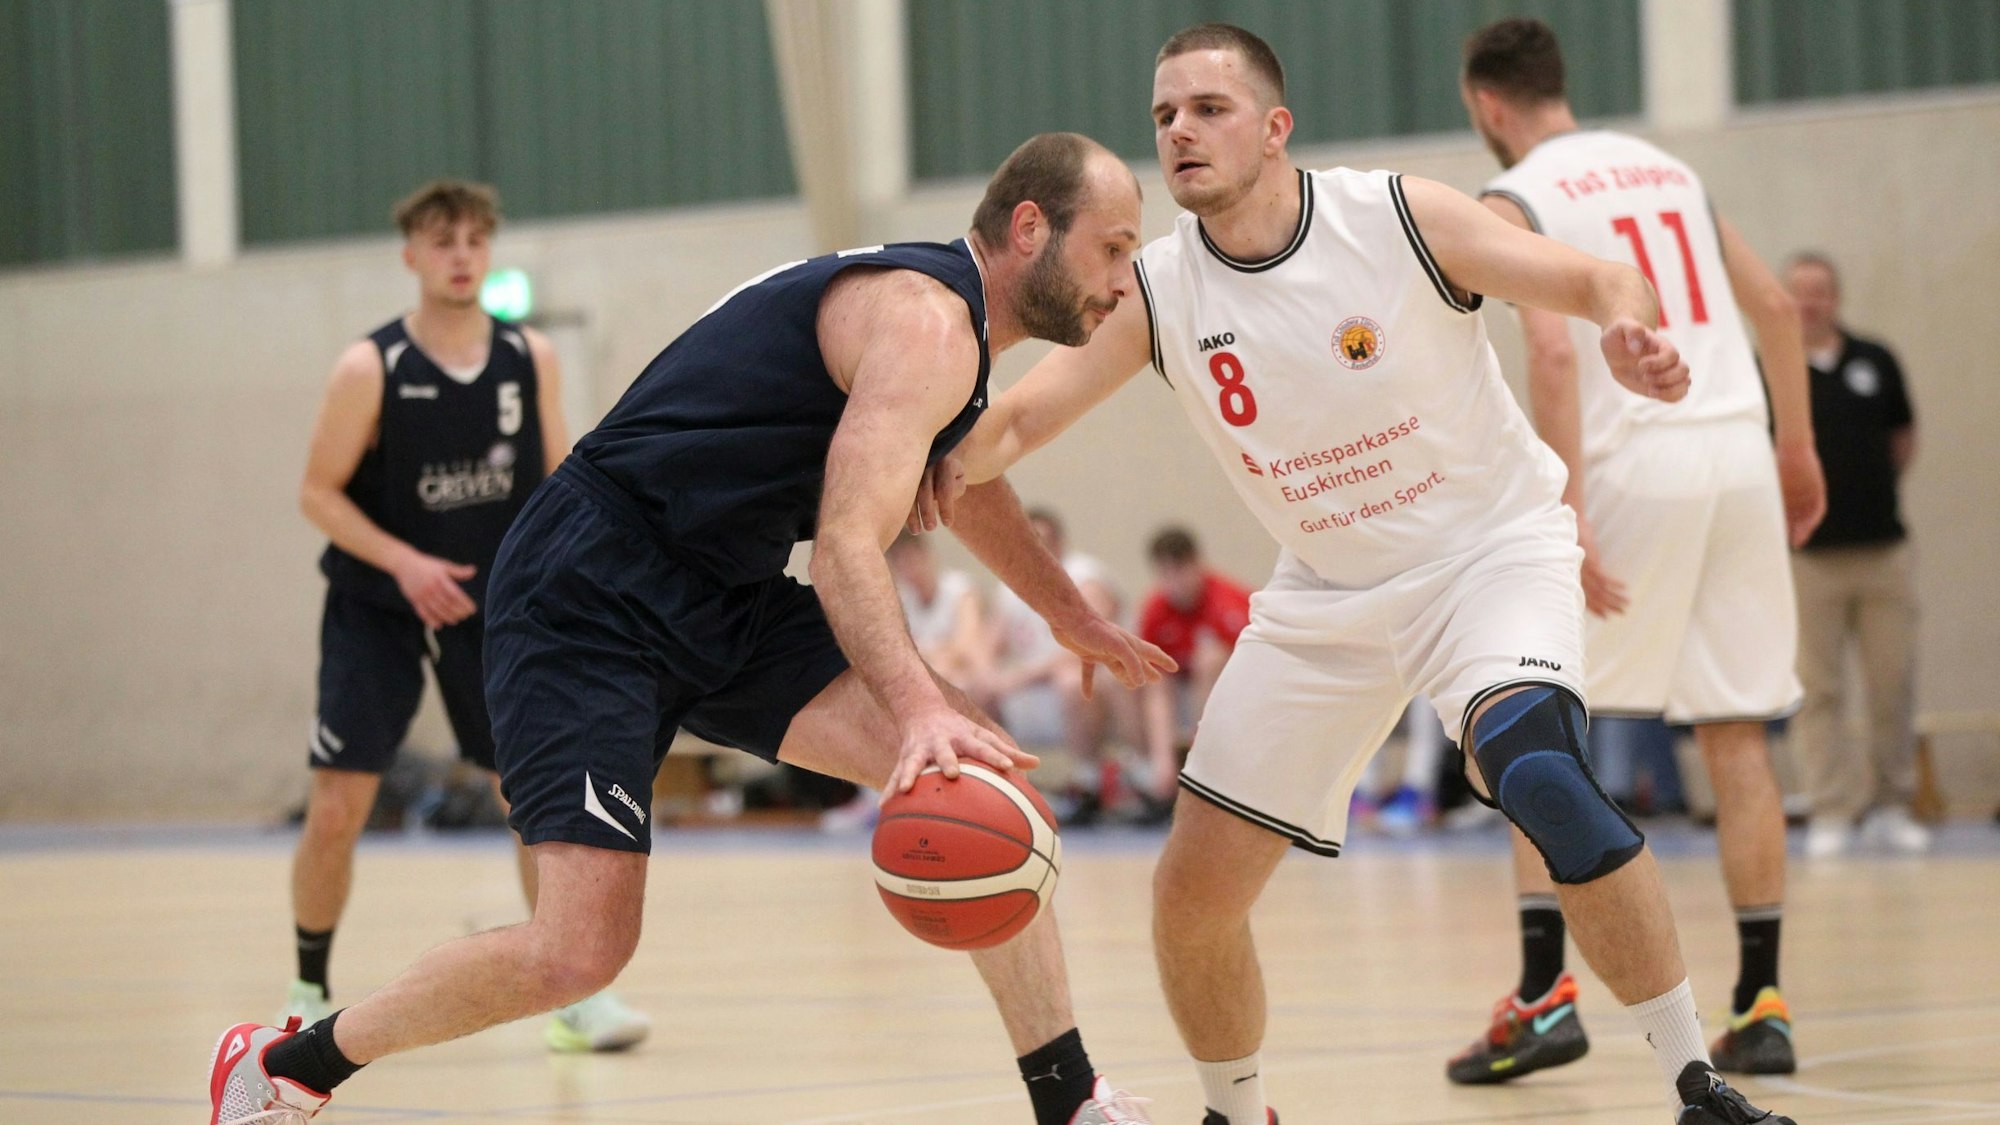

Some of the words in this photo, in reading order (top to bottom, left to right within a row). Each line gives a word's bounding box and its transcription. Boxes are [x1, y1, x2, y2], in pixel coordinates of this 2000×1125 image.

[1557, 170, 1607, 201] TuS
[1611, 211, 1708, 328] 11
[497, 382, 523, 435] 5
[1209, 352, 1257, 427] 8
[1269, 416, 1421, 479] Kreissparkasse
[1281, 457, 1393, 503] Euskirchen
[1300, 516, 1331, 534] Gut
[1332, 510, 1356, 527] für
[1360, 499, 1393, 520] den
[1394, 470, 1446, 507] Sport.
[608, 783, 647, 825] SPALDING
